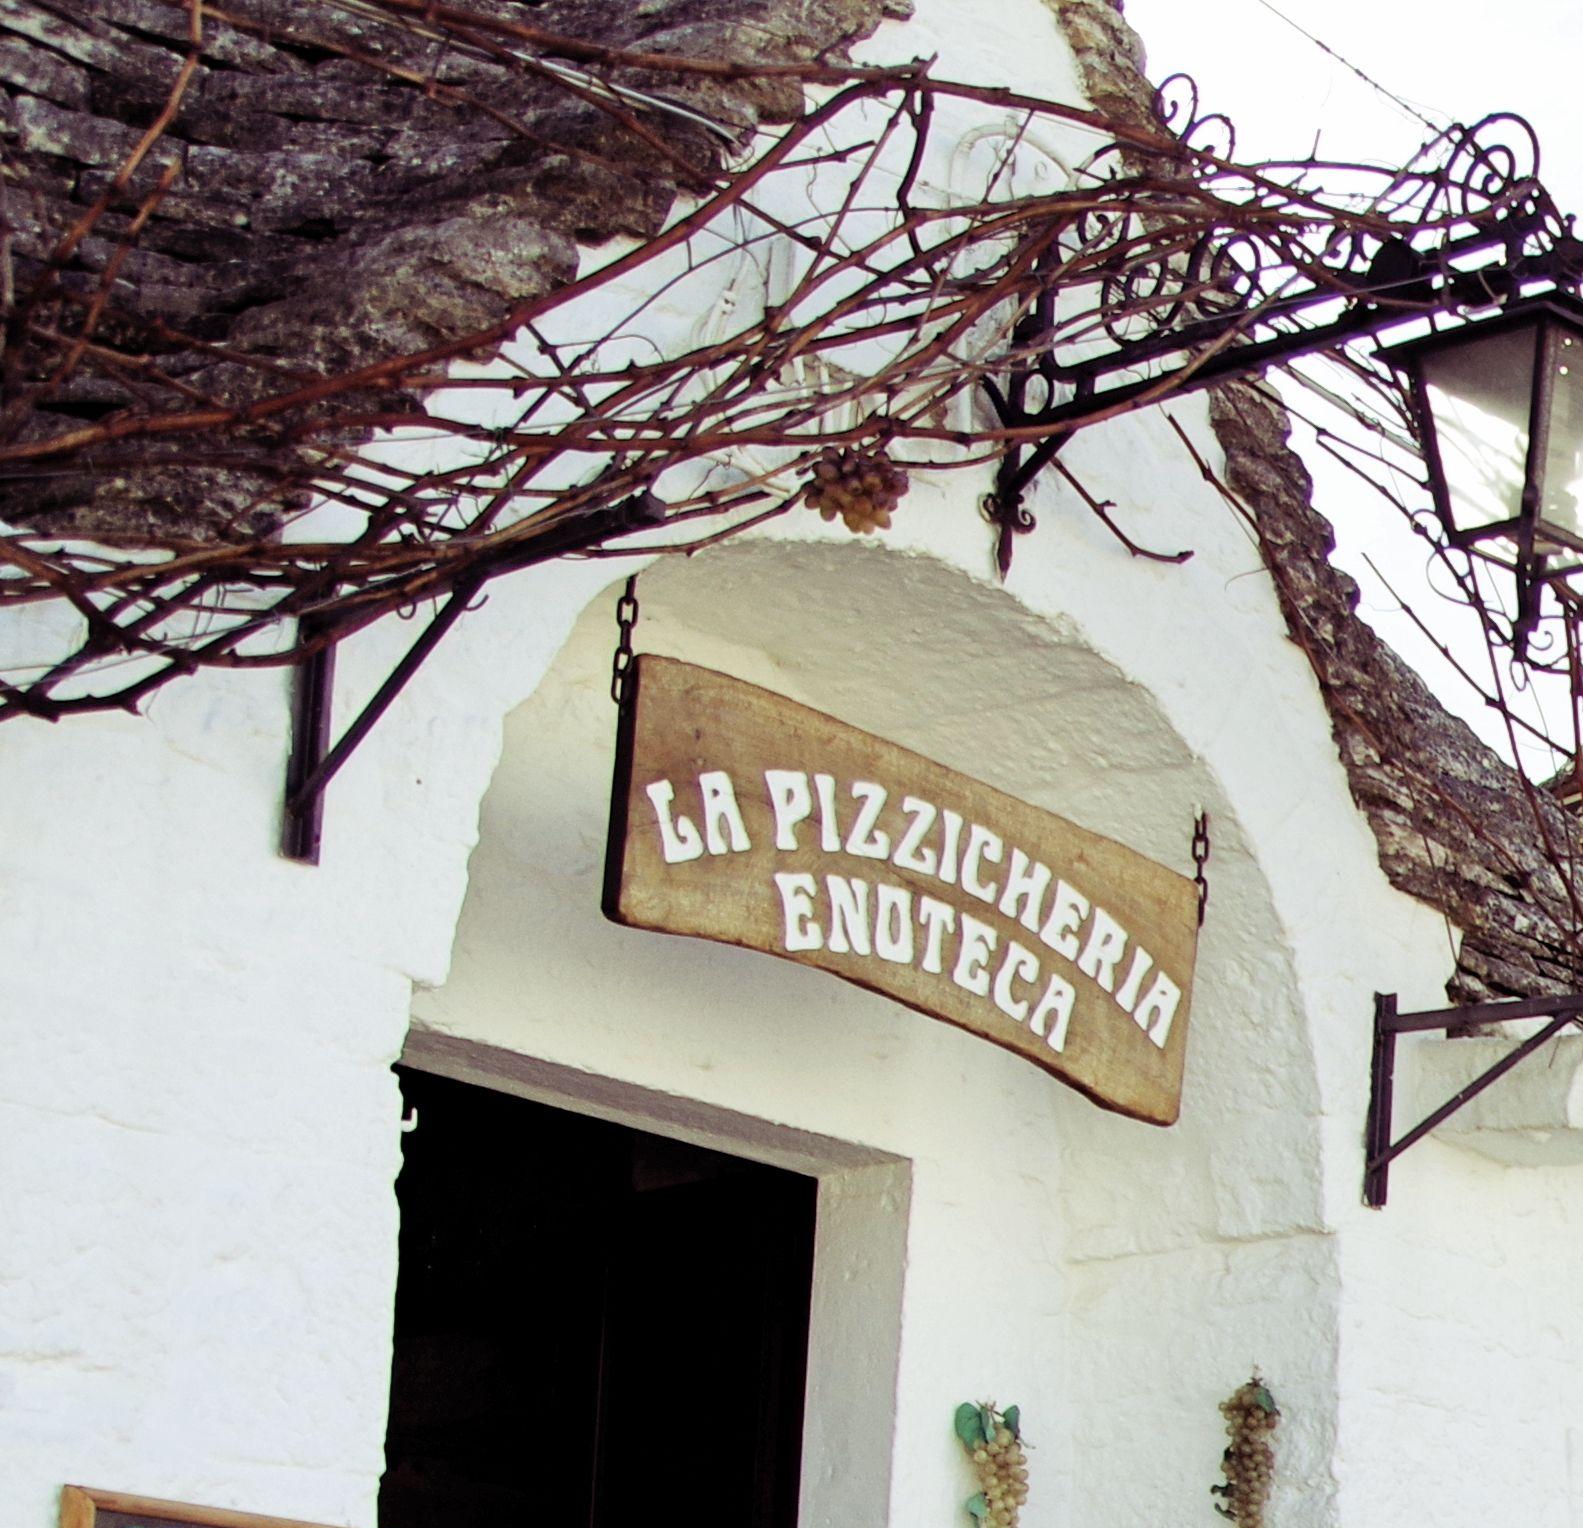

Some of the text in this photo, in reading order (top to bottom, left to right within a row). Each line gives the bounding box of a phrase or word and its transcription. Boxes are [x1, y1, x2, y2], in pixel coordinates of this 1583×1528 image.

[646, 769, 1182, 1050] LA PIZZICHERIA
[773, 871, 1076, 1053] ENOTECA
